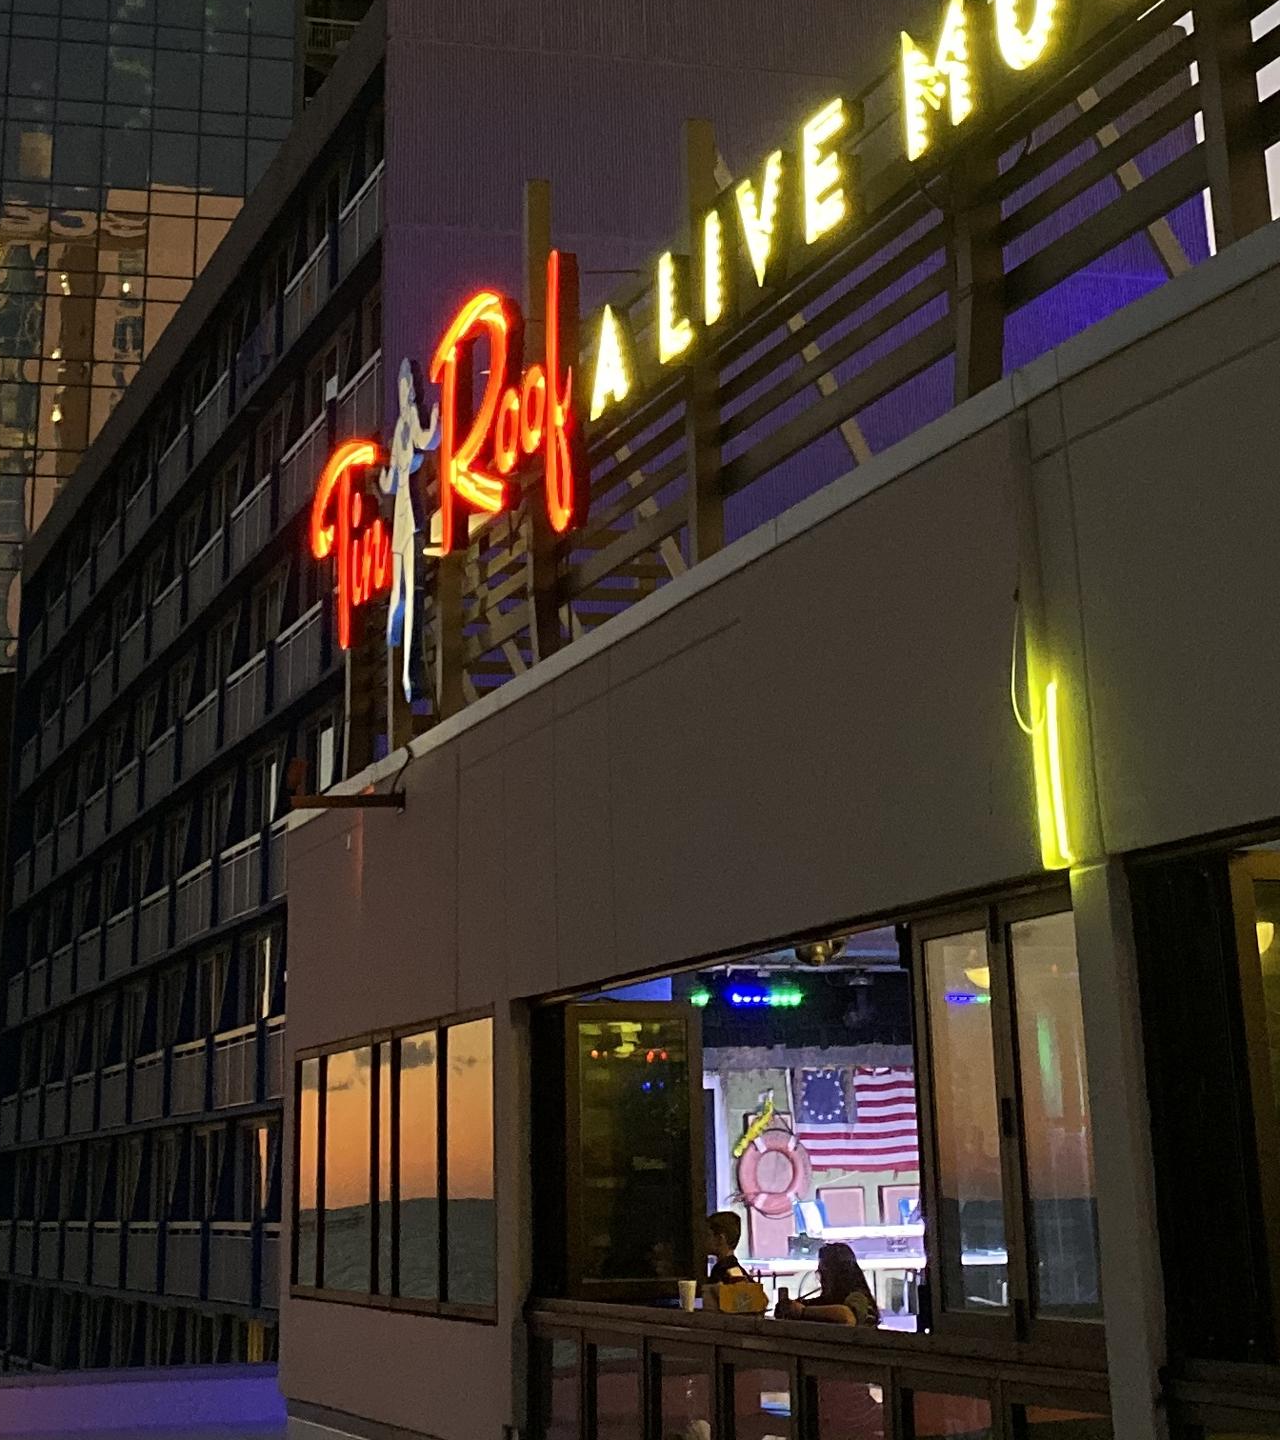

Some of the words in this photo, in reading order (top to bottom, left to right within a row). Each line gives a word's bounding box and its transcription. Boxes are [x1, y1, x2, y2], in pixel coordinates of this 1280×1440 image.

[589, 303, 632, 422] A
[657, 97, 849, 365] LIVE
[311, 439, 394, 650] Tin
[427, 248, 574, 534] Roof
